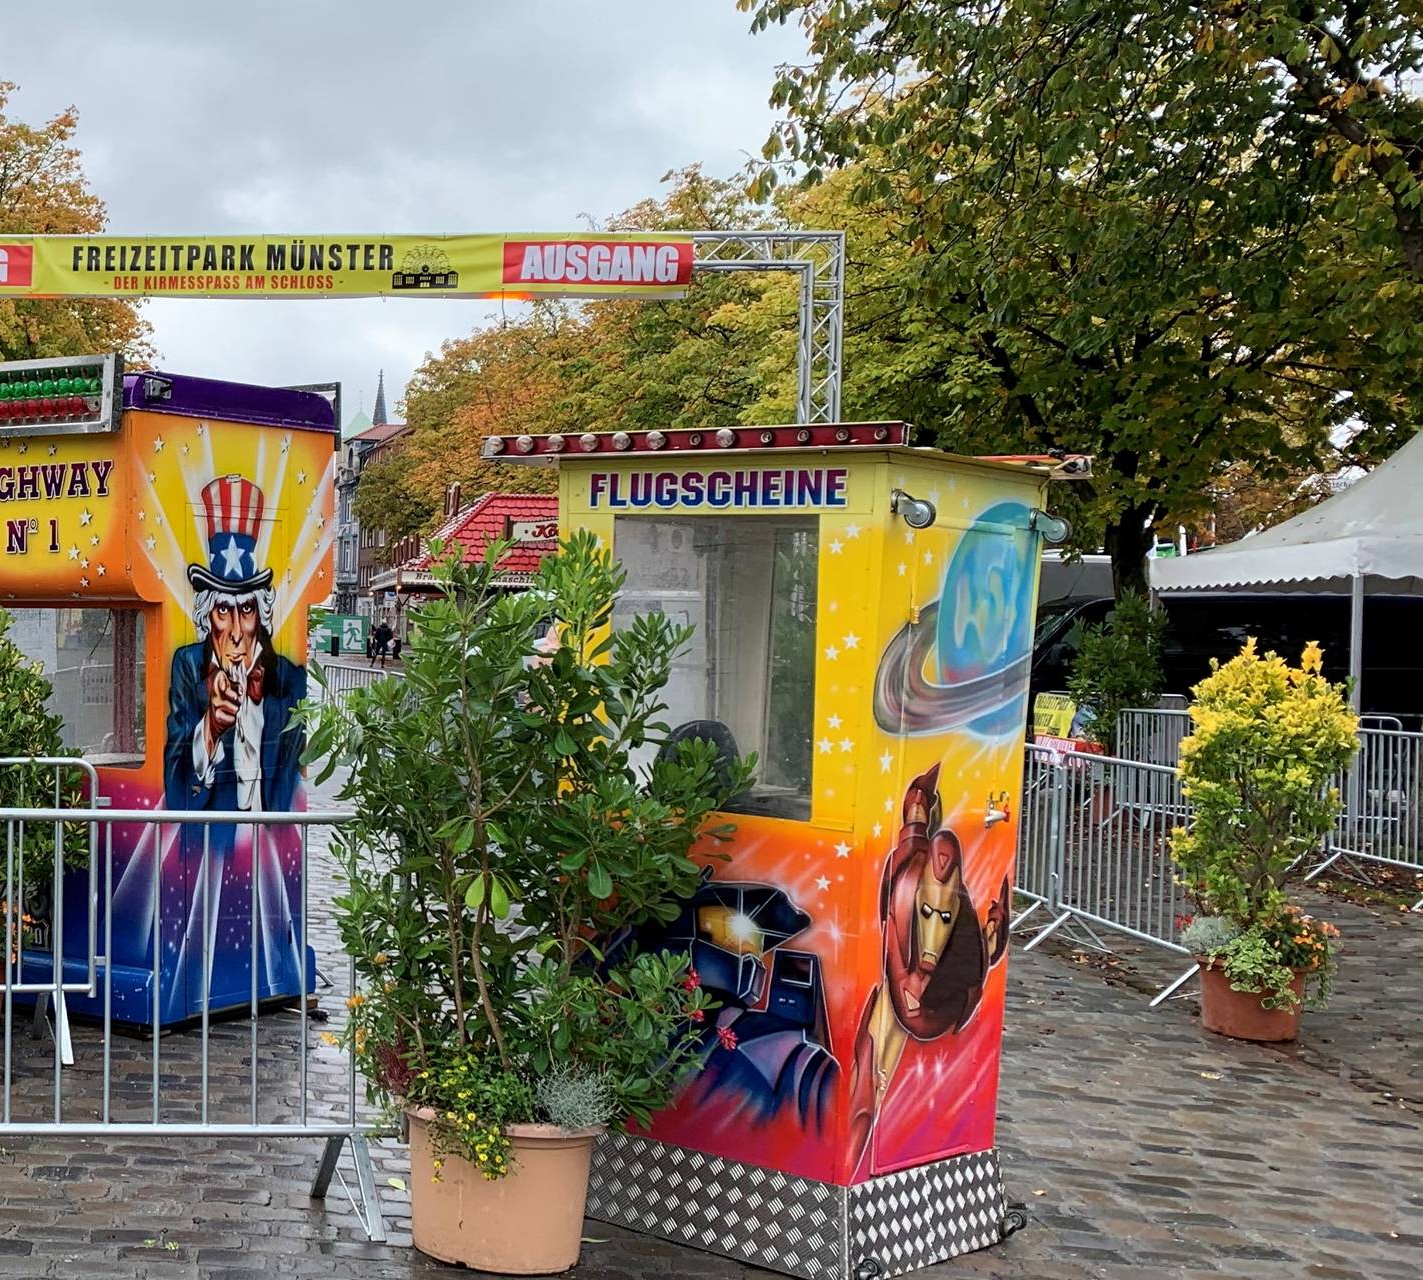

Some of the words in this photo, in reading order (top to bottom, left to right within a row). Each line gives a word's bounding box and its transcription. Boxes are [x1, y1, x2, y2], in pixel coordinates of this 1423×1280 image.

[72, 244, 256, 272] FREIZEITPARK
[266, 240, 394, 271] MÜNSTER
[520, 244, 680, 283] AUSGANG
[113, 275, 139, 290] DER
[144, 275, 240, 290] KIRMESSPASS
[245, 275, 265, 289] AM
[271, 275, 334, 289] SCHLOSS
[589, 467, 849, 511] FLUGSCHEINE
[48, 516, 60, 554] 1
